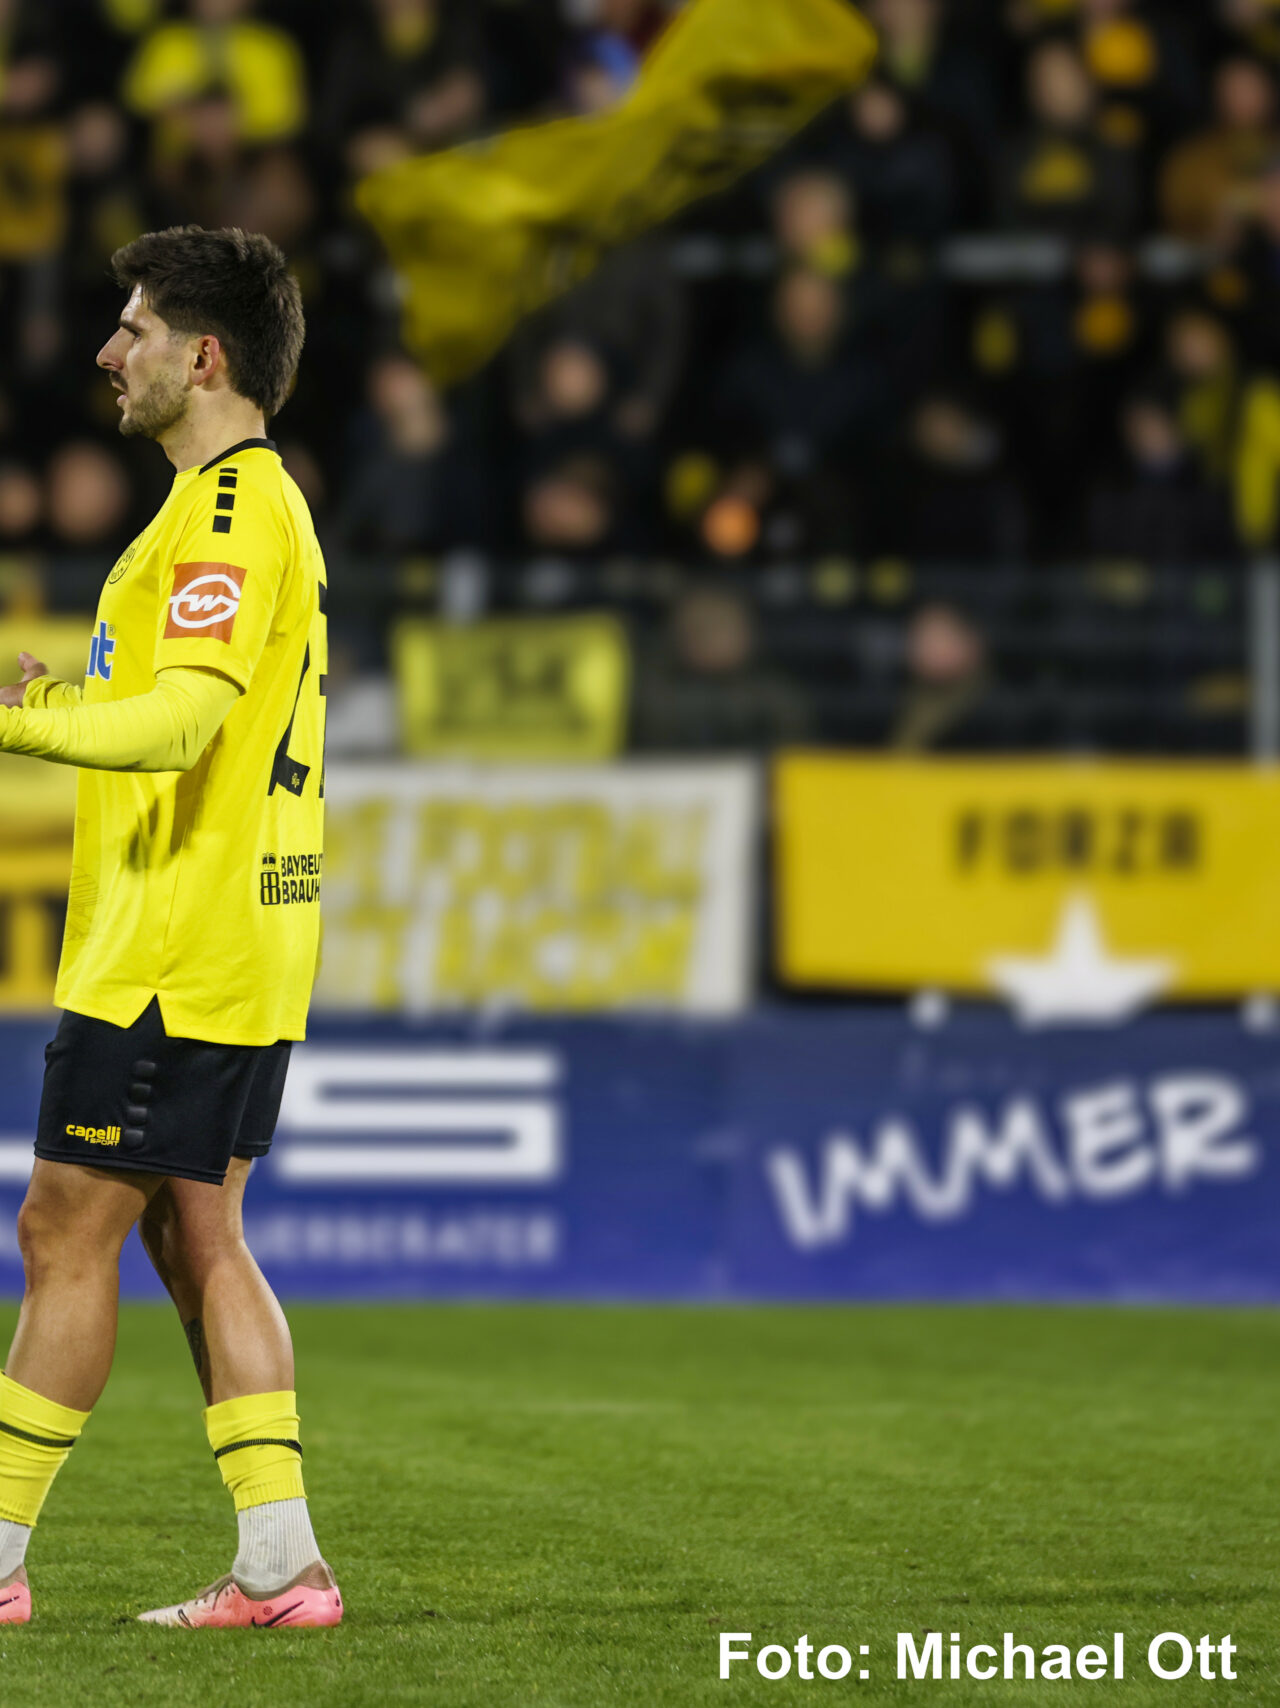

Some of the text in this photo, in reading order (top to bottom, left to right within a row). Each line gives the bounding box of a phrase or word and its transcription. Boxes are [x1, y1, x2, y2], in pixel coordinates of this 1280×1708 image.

[956, 806, 1203, 873] FORZA
[65, 1124, 121, 1141] capelli
[90, 1137, 119, 1146] SPORT
[772, 1074, 1257, 1248] IMMER
